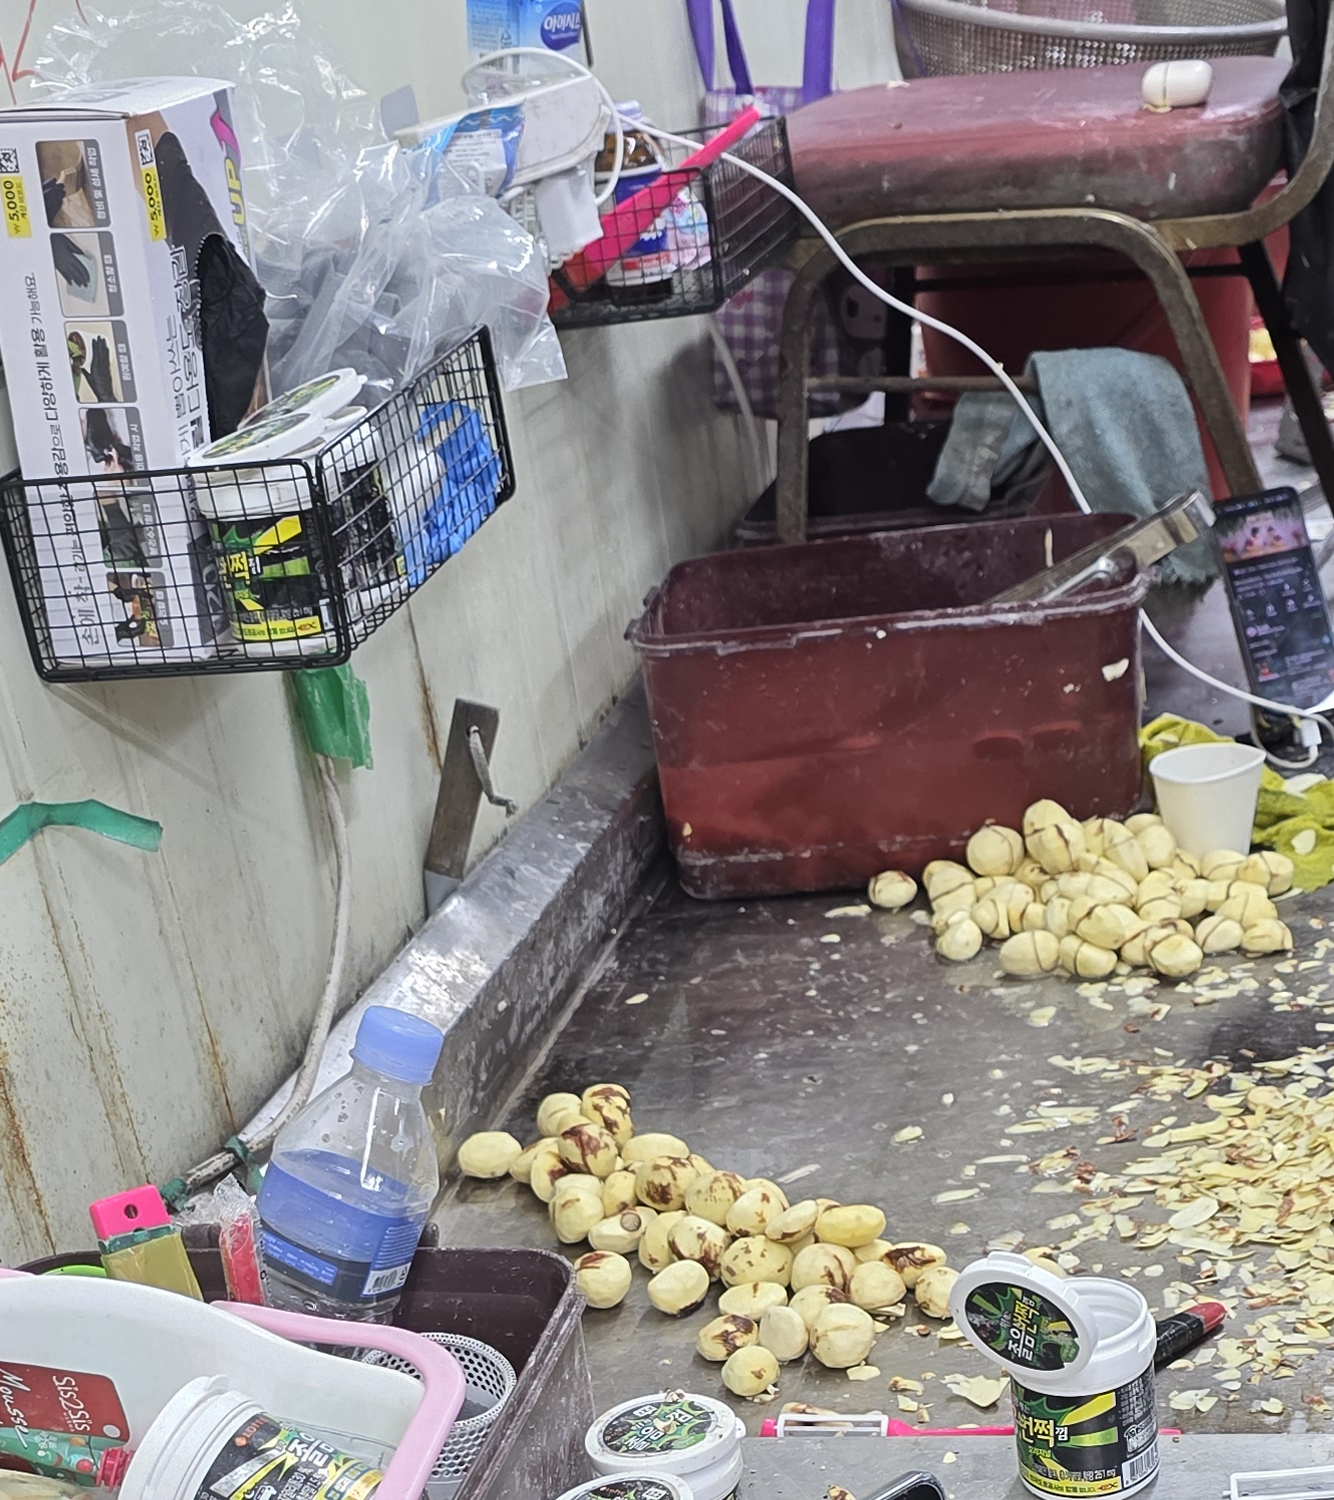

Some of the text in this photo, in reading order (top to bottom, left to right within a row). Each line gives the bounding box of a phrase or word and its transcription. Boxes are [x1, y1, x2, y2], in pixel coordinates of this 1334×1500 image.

[3, 180, 20, 221] 5,000
[145, 172, 160, 222] 5,000
[224, 157, 246, 226] UP
[25, 272, 42, 325] 가능해요.
[31, 328, 49, 358] 활용
[36, 361, 59, 421] 다양하게
[1007, 1295, 1041, 1362] 졸음번쩍껌
[52, 1375, 93, 1432] Sis2Sis
